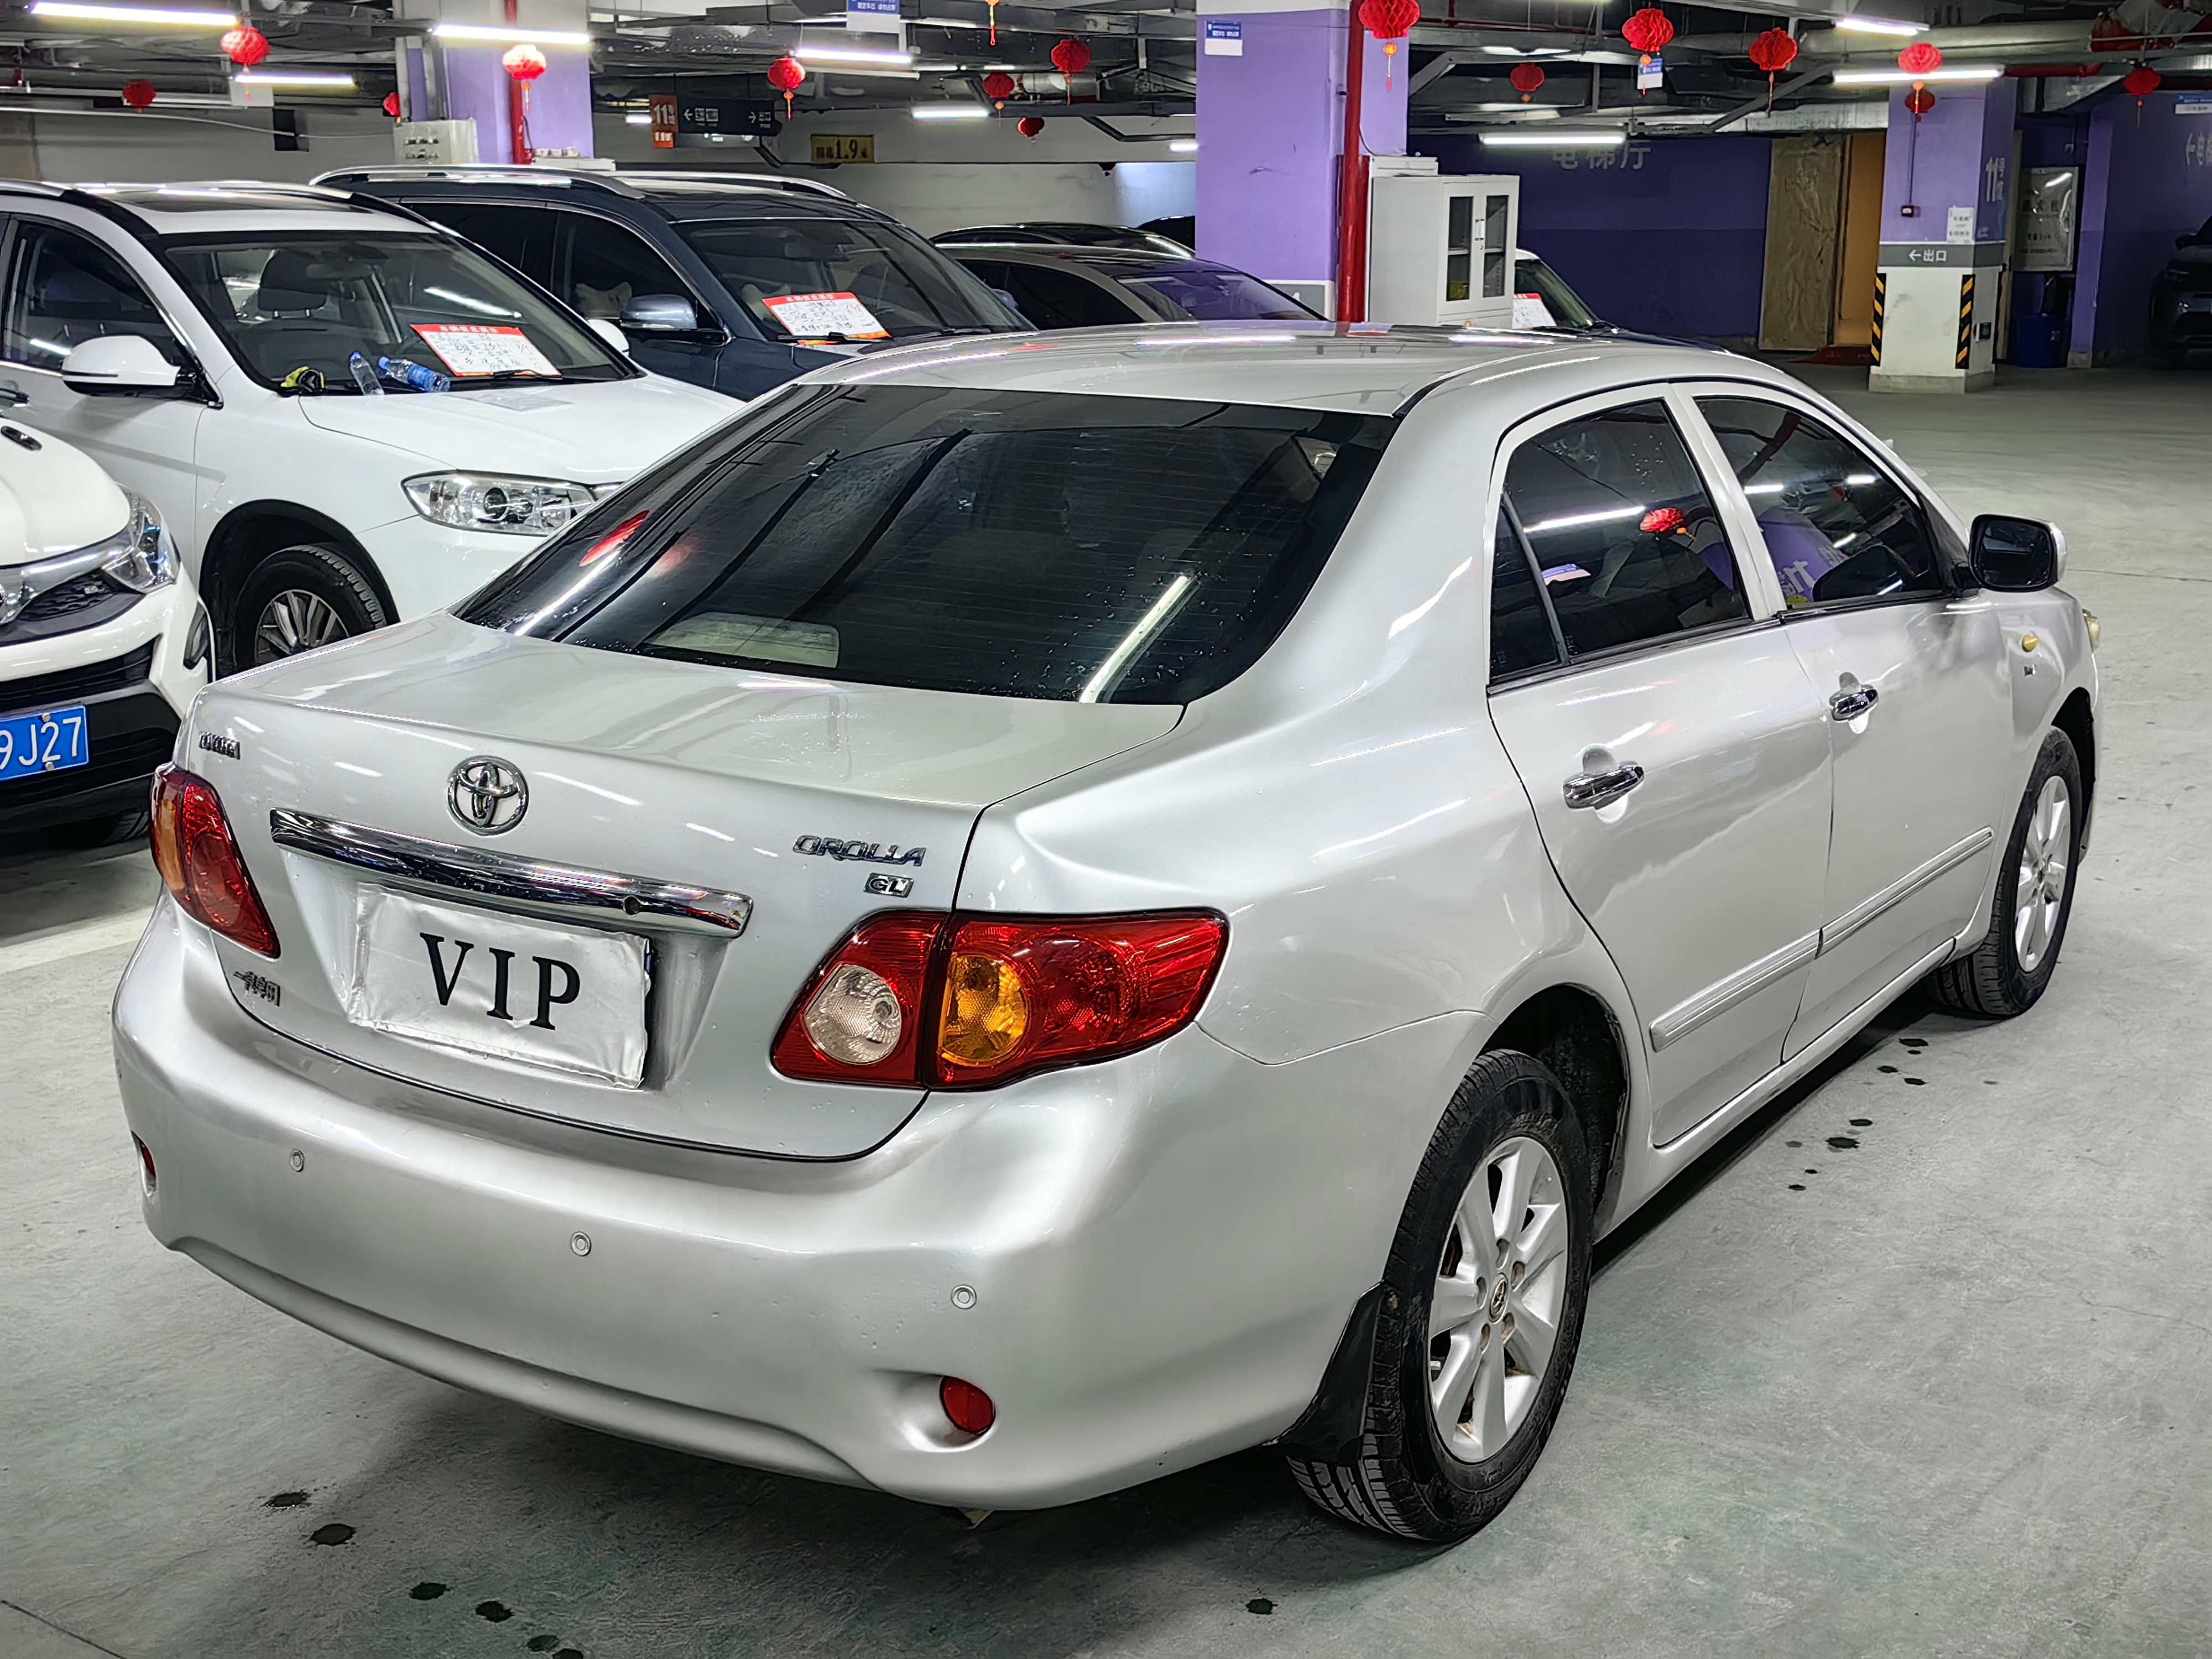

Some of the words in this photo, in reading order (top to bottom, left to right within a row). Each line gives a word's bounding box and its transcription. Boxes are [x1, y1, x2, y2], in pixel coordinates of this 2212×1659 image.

[1923, 249, 1947, 262] 出口
[0, 716, 82, 770] 9J27
[869, 878, 902, 894] GL
[233, 971, 280, 1007] 一汽丰田
[419, 932, 581, 1031] VIP
